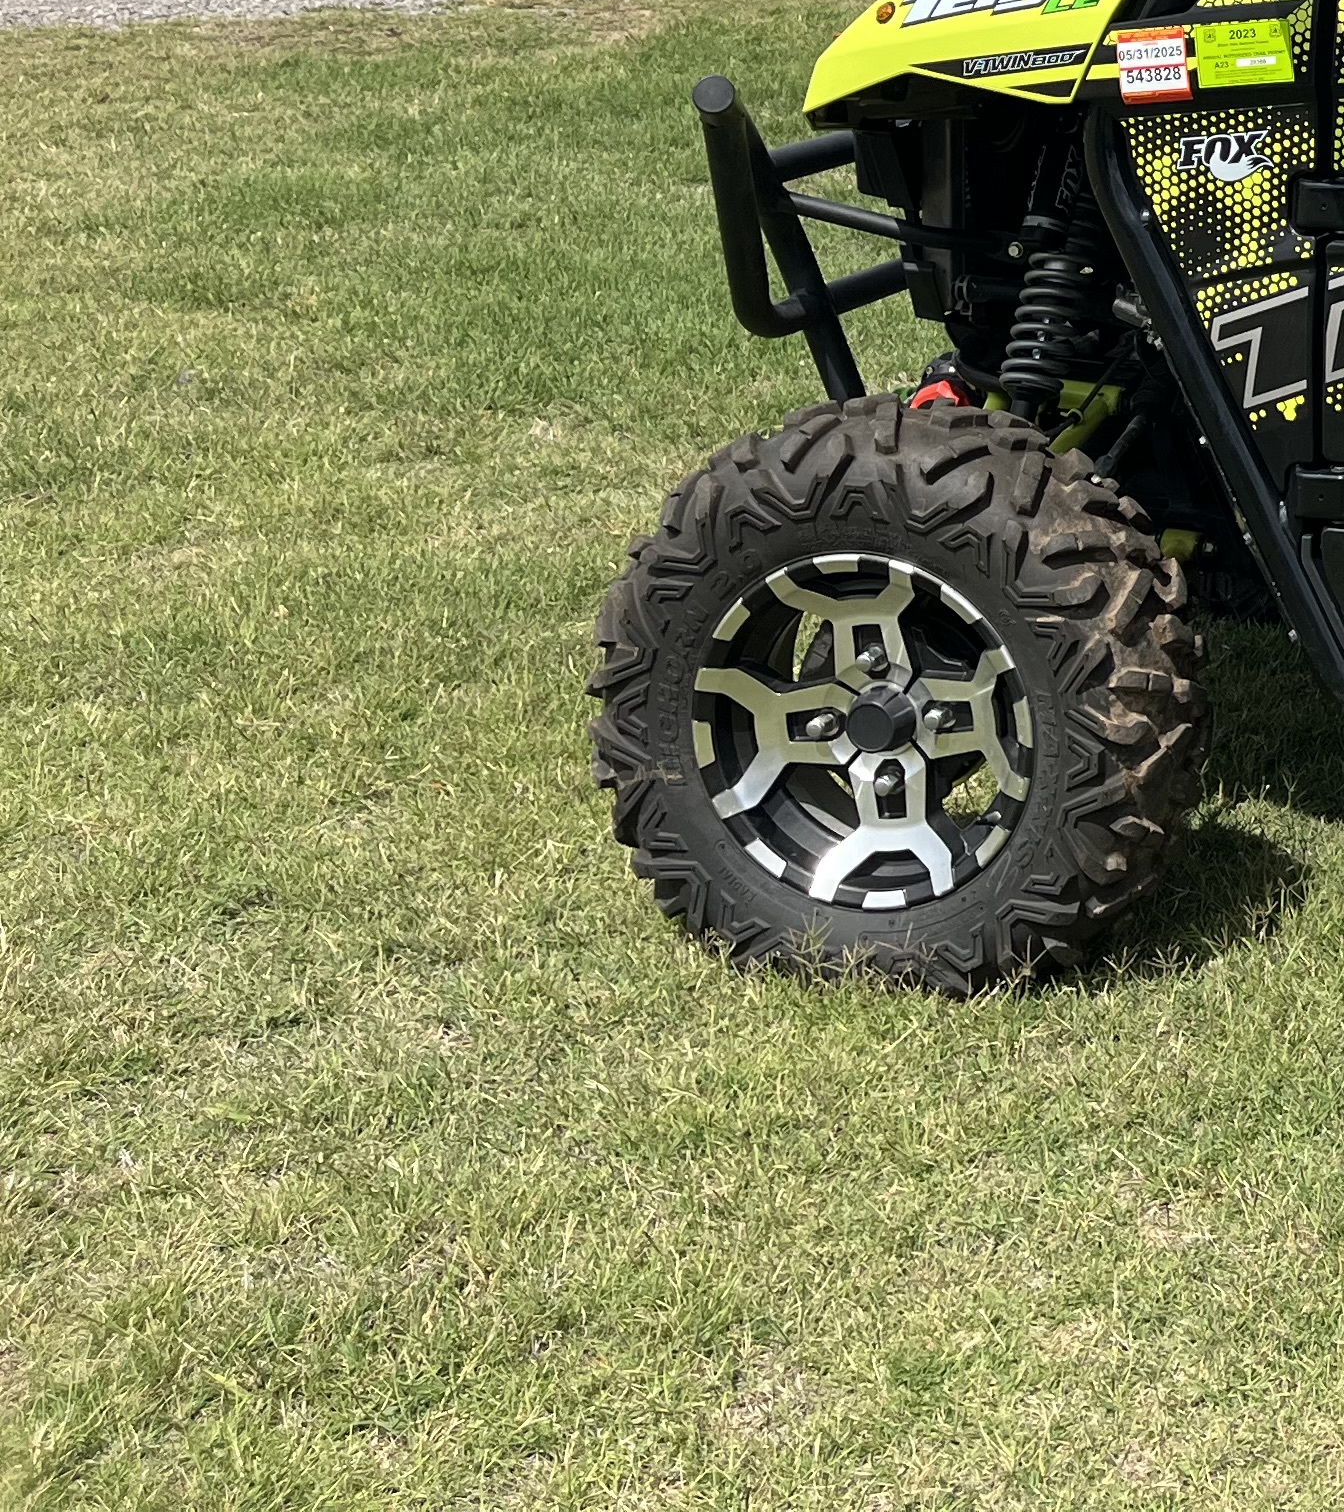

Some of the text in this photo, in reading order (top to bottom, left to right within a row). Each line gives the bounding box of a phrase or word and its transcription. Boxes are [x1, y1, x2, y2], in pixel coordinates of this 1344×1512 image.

[1228, 28, 1257, 40] 2023
[1118, 45, 1183, 62] 05/31/2025
[1126, 66, 1182, 85] 543828
[1176, 129, 1269, 172] FOX
